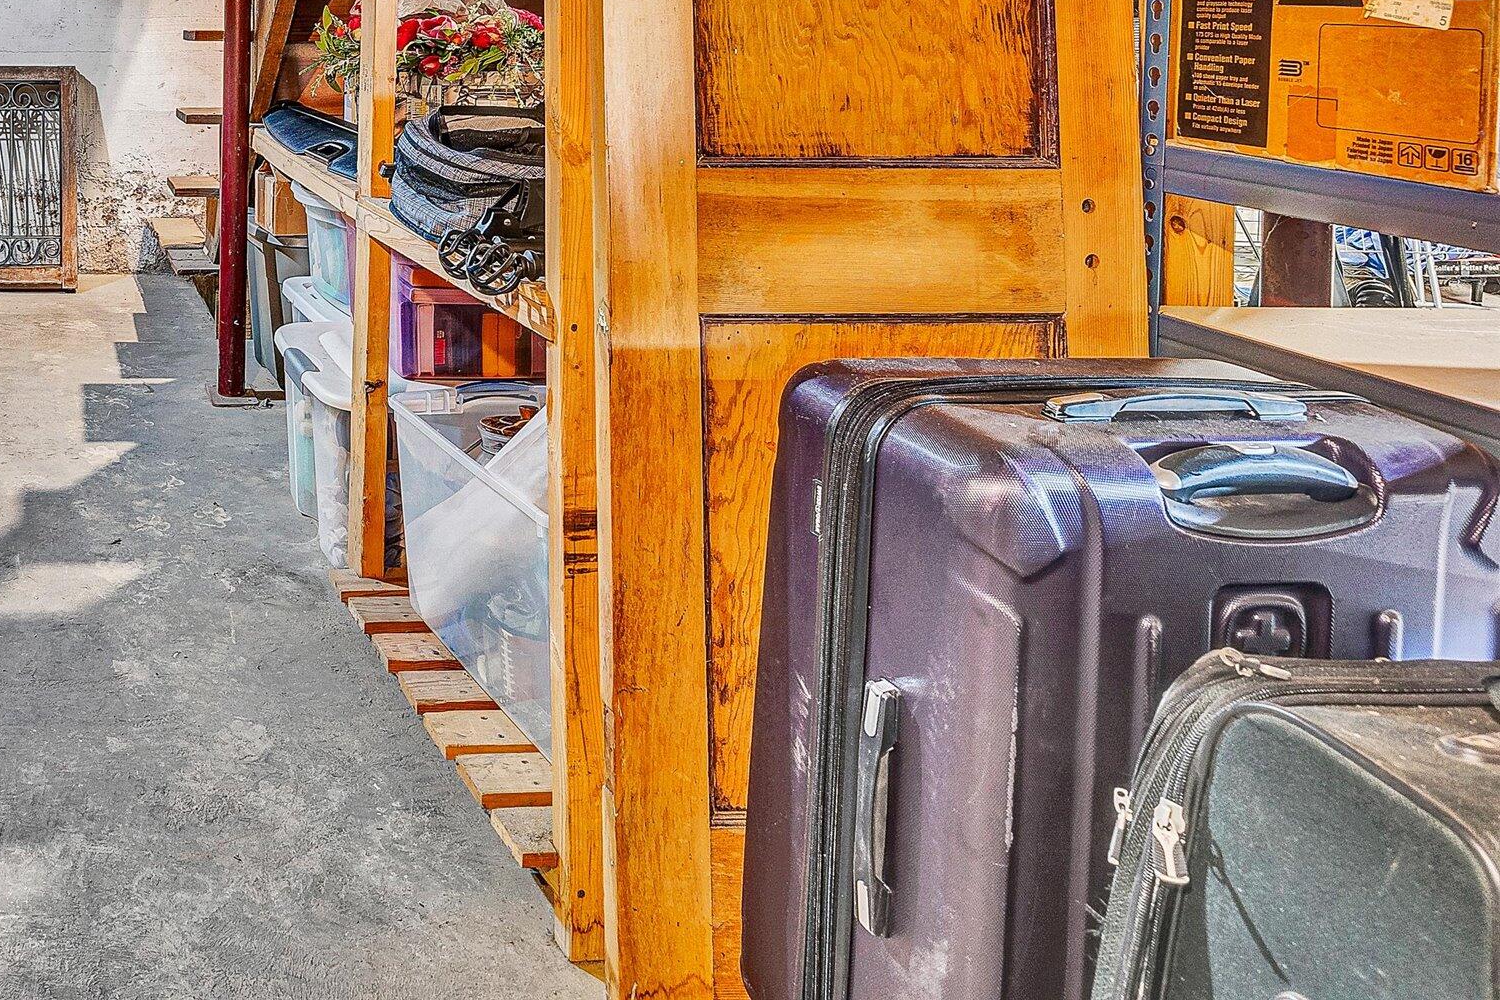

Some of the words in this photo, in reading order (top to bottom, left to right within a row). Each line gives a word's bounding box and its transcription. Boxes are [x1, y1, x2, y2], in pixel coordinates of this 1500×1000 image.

[1439, 15, 1447, 26] 5
[1196, 21, 1211, 30] Fast
[1212, 21, 1230, 31] Print
[1230, 22, 1253, 32] Speed
[1194, 53, 1233, 64] Convenient
[1234, 55, 1256, 65] Paper
[1194, 62, 1224, 74] Handling
[1193, 93, 1217, 103] Quieter
[1218, 96, 1234, 105] Than
[1241, 97, 1261, 108] Laser
[1192, 103, 1205, 111] Prints
[1192, 112, 1222, 123] Compact
[1223, 115, 1248, 128] Design
[1192, 121, 1200, 129] Fits
[1201, 123, 1219, 132] virtually
[1352, 141, 1370, 149] Printed
[1457, 153, 1473, 166] 16
